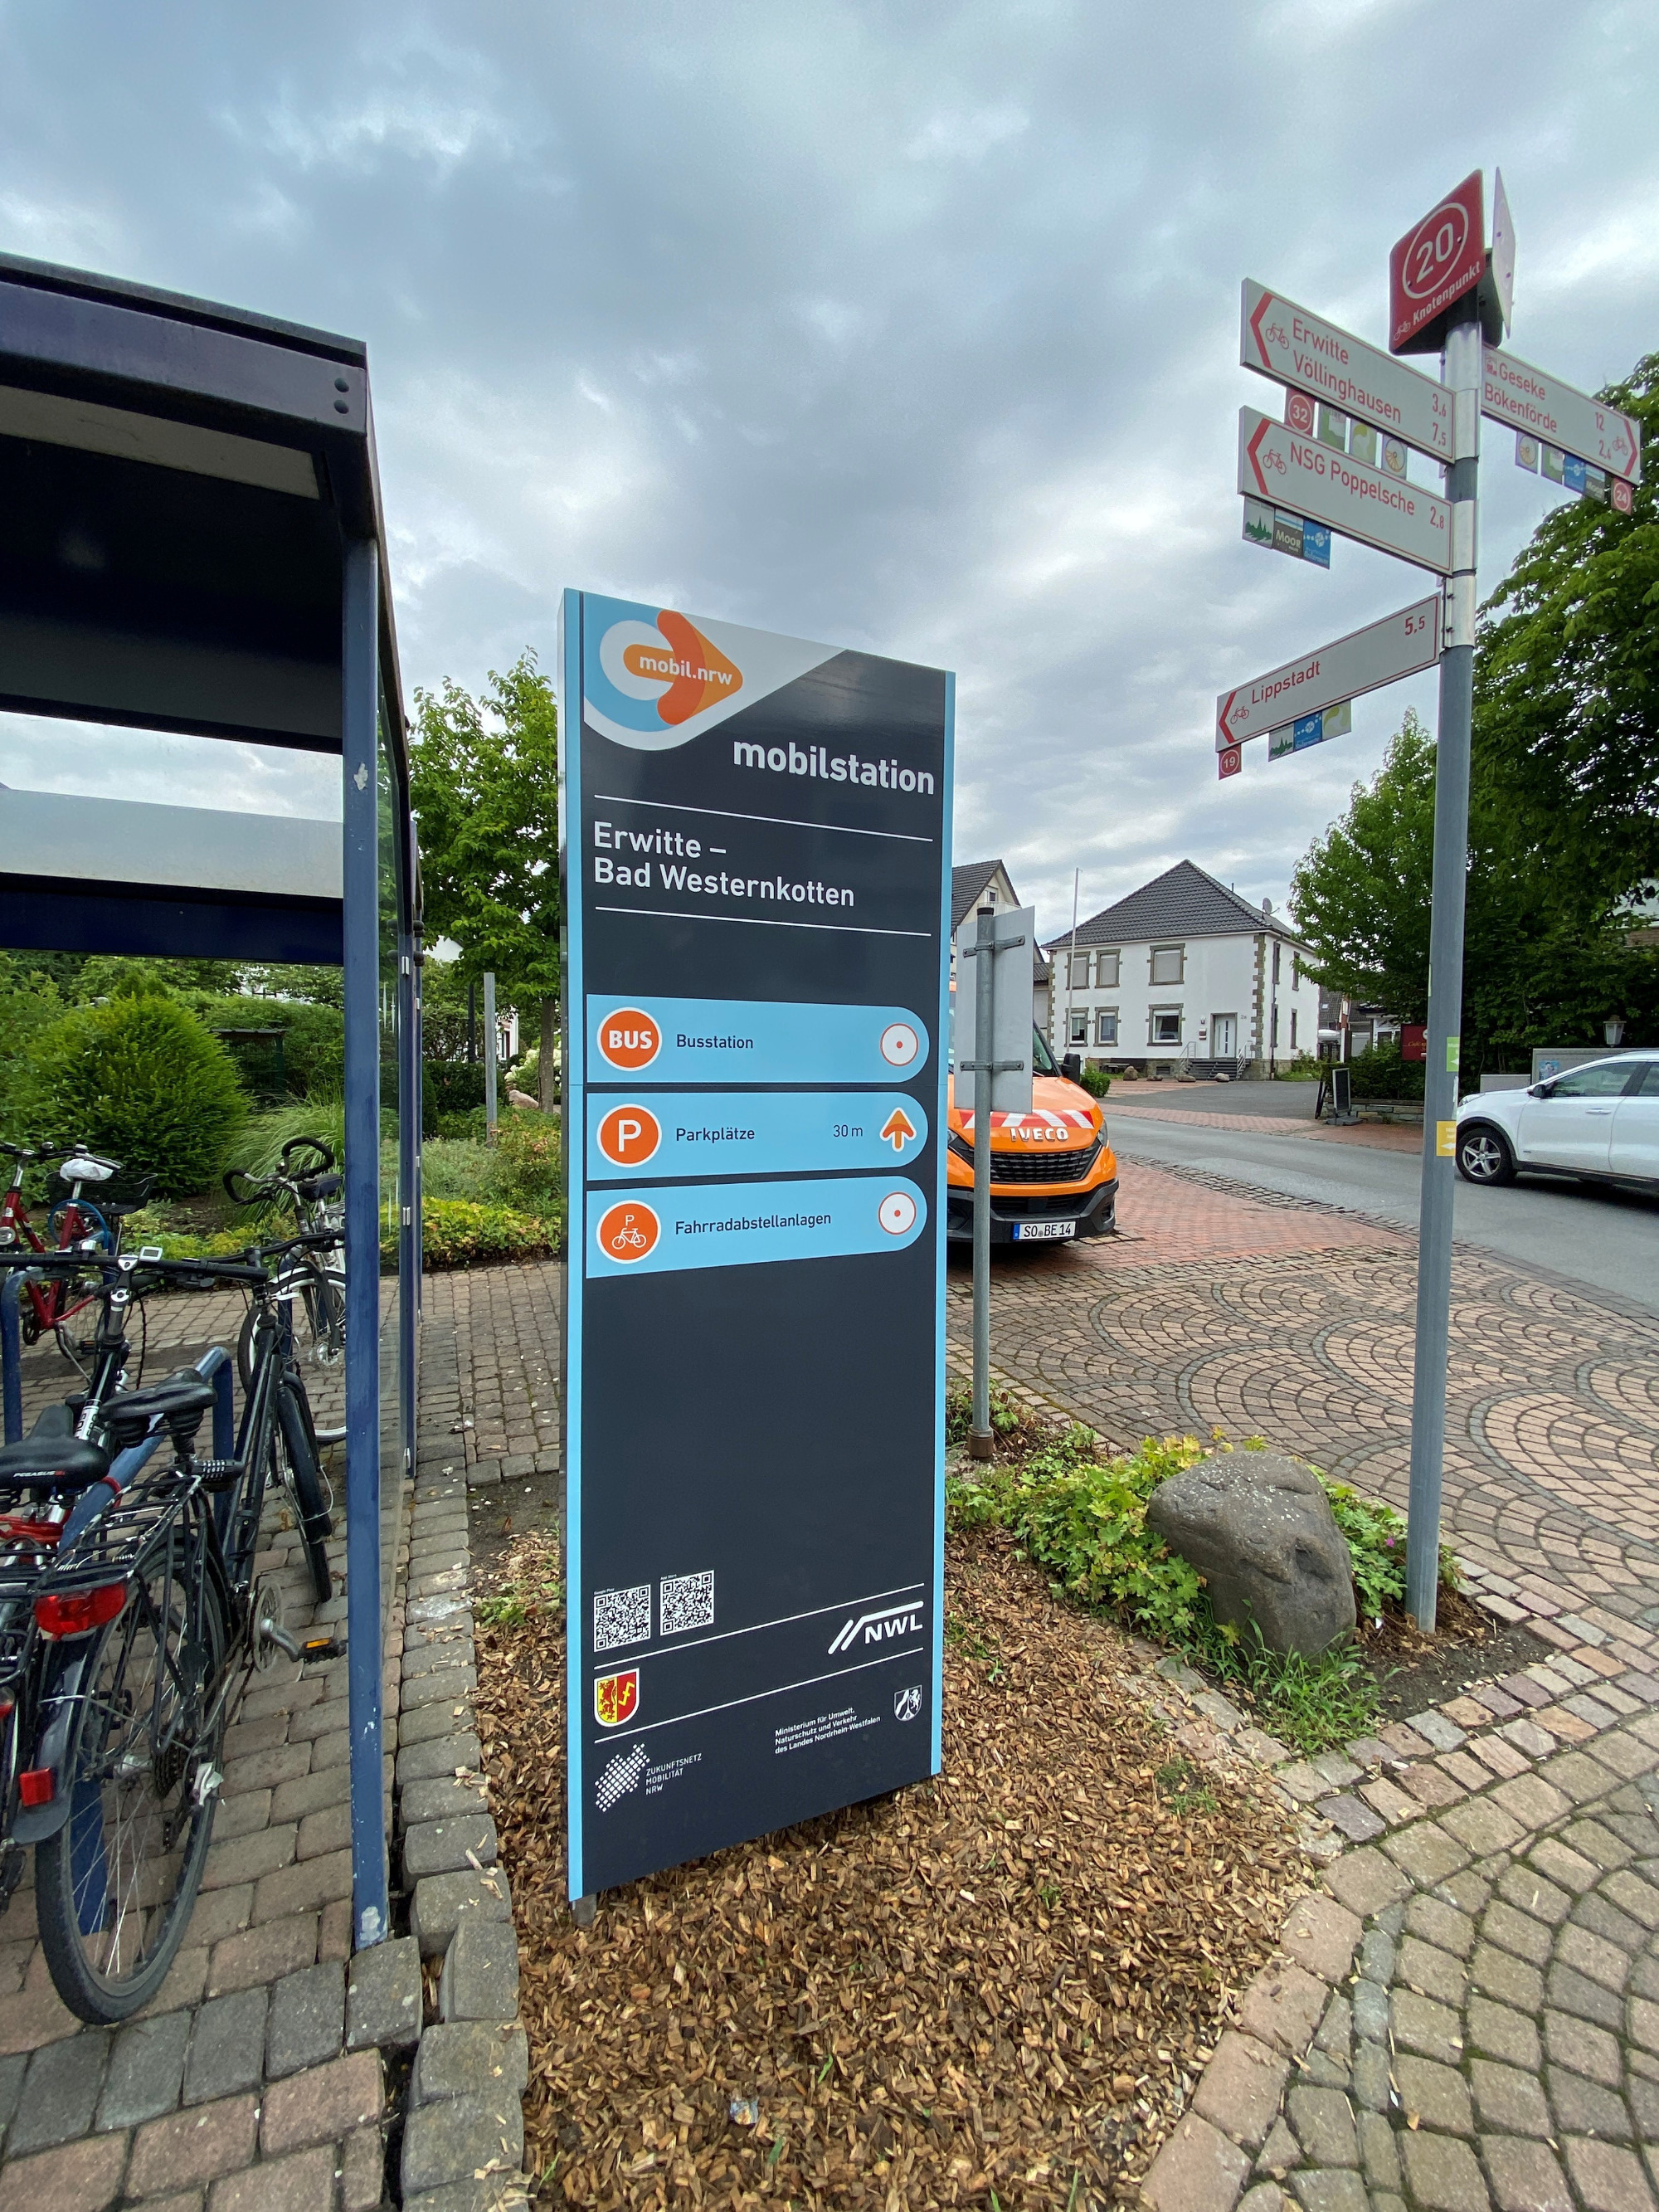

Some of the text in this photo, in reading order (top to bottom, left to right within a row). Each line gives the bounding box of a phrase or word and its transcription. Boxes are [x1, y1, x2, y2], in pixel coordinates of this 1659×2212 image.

[1416, 222, 1453, 283] 20
[1413, 261, 1480, 325] Knotenpunkt
[1292, 317, 1349, 365] Erwitte
[1293, 349, 1400, 424] Völlinghausen
[1499, 362, 1545, 401] Geseke
[1292, 405, 1308, 423] 32
[1485, 382, 1557, 433] Bökenförde
[1595, 412, 1604, 431] 12
[1290, 441, 1415, 515] NSG Poppelsche
[1616, 490, 1627, 505] 24
[1276, 529, 1301, 548] MOOR
[1404, 615, 1426, 636] 5,5
[640, 654, 732, 686] mobil.nrw
[1252, 660, 1321, 704] Lippstadt
[733, 740, 935, 795] mobilstation
[1223, 756, 1236, 769] 19
[594, 821, 702, 859] Erwitte
[594, 857, 855, 907] Bad Westernkotten
[608, 1029, 653, 1050] BUS
[676, 1034, 754, 1050] Busstation
[618, 1119, 642, 1152] P
[676, 1125, 756, 1144] Parkplätze
[833, 1124, 864, 1138] 30 m
[1010, 1127, 1069, 1143] IVECO
[625, 1214, 635, 1226] P
[675, 1213, 832, 1235] Fahrradabstellanlagen
[1023, 1225, 1038, 1238] SO
[1044, 1224, 1058, 1237] BE
[1058, 1223, 1071, 1235] 14
[864, 1615, 923, 1644] NWL
[775, 1719, 816, 1737] Ministerium
[817, 1715, 827, 1725] für
[775, 1714, 858, 1745] Naturschutz und Verkehr
[775, 1716, 881, 1754] des Landes Nordrhein-Westfalen
[646, 1752, 703, 1776] ZUKUNFTSNETZ
[645, 1767, 684, 1786] MOBILITÄT
[645, 1783, 664, 1795] NRW
